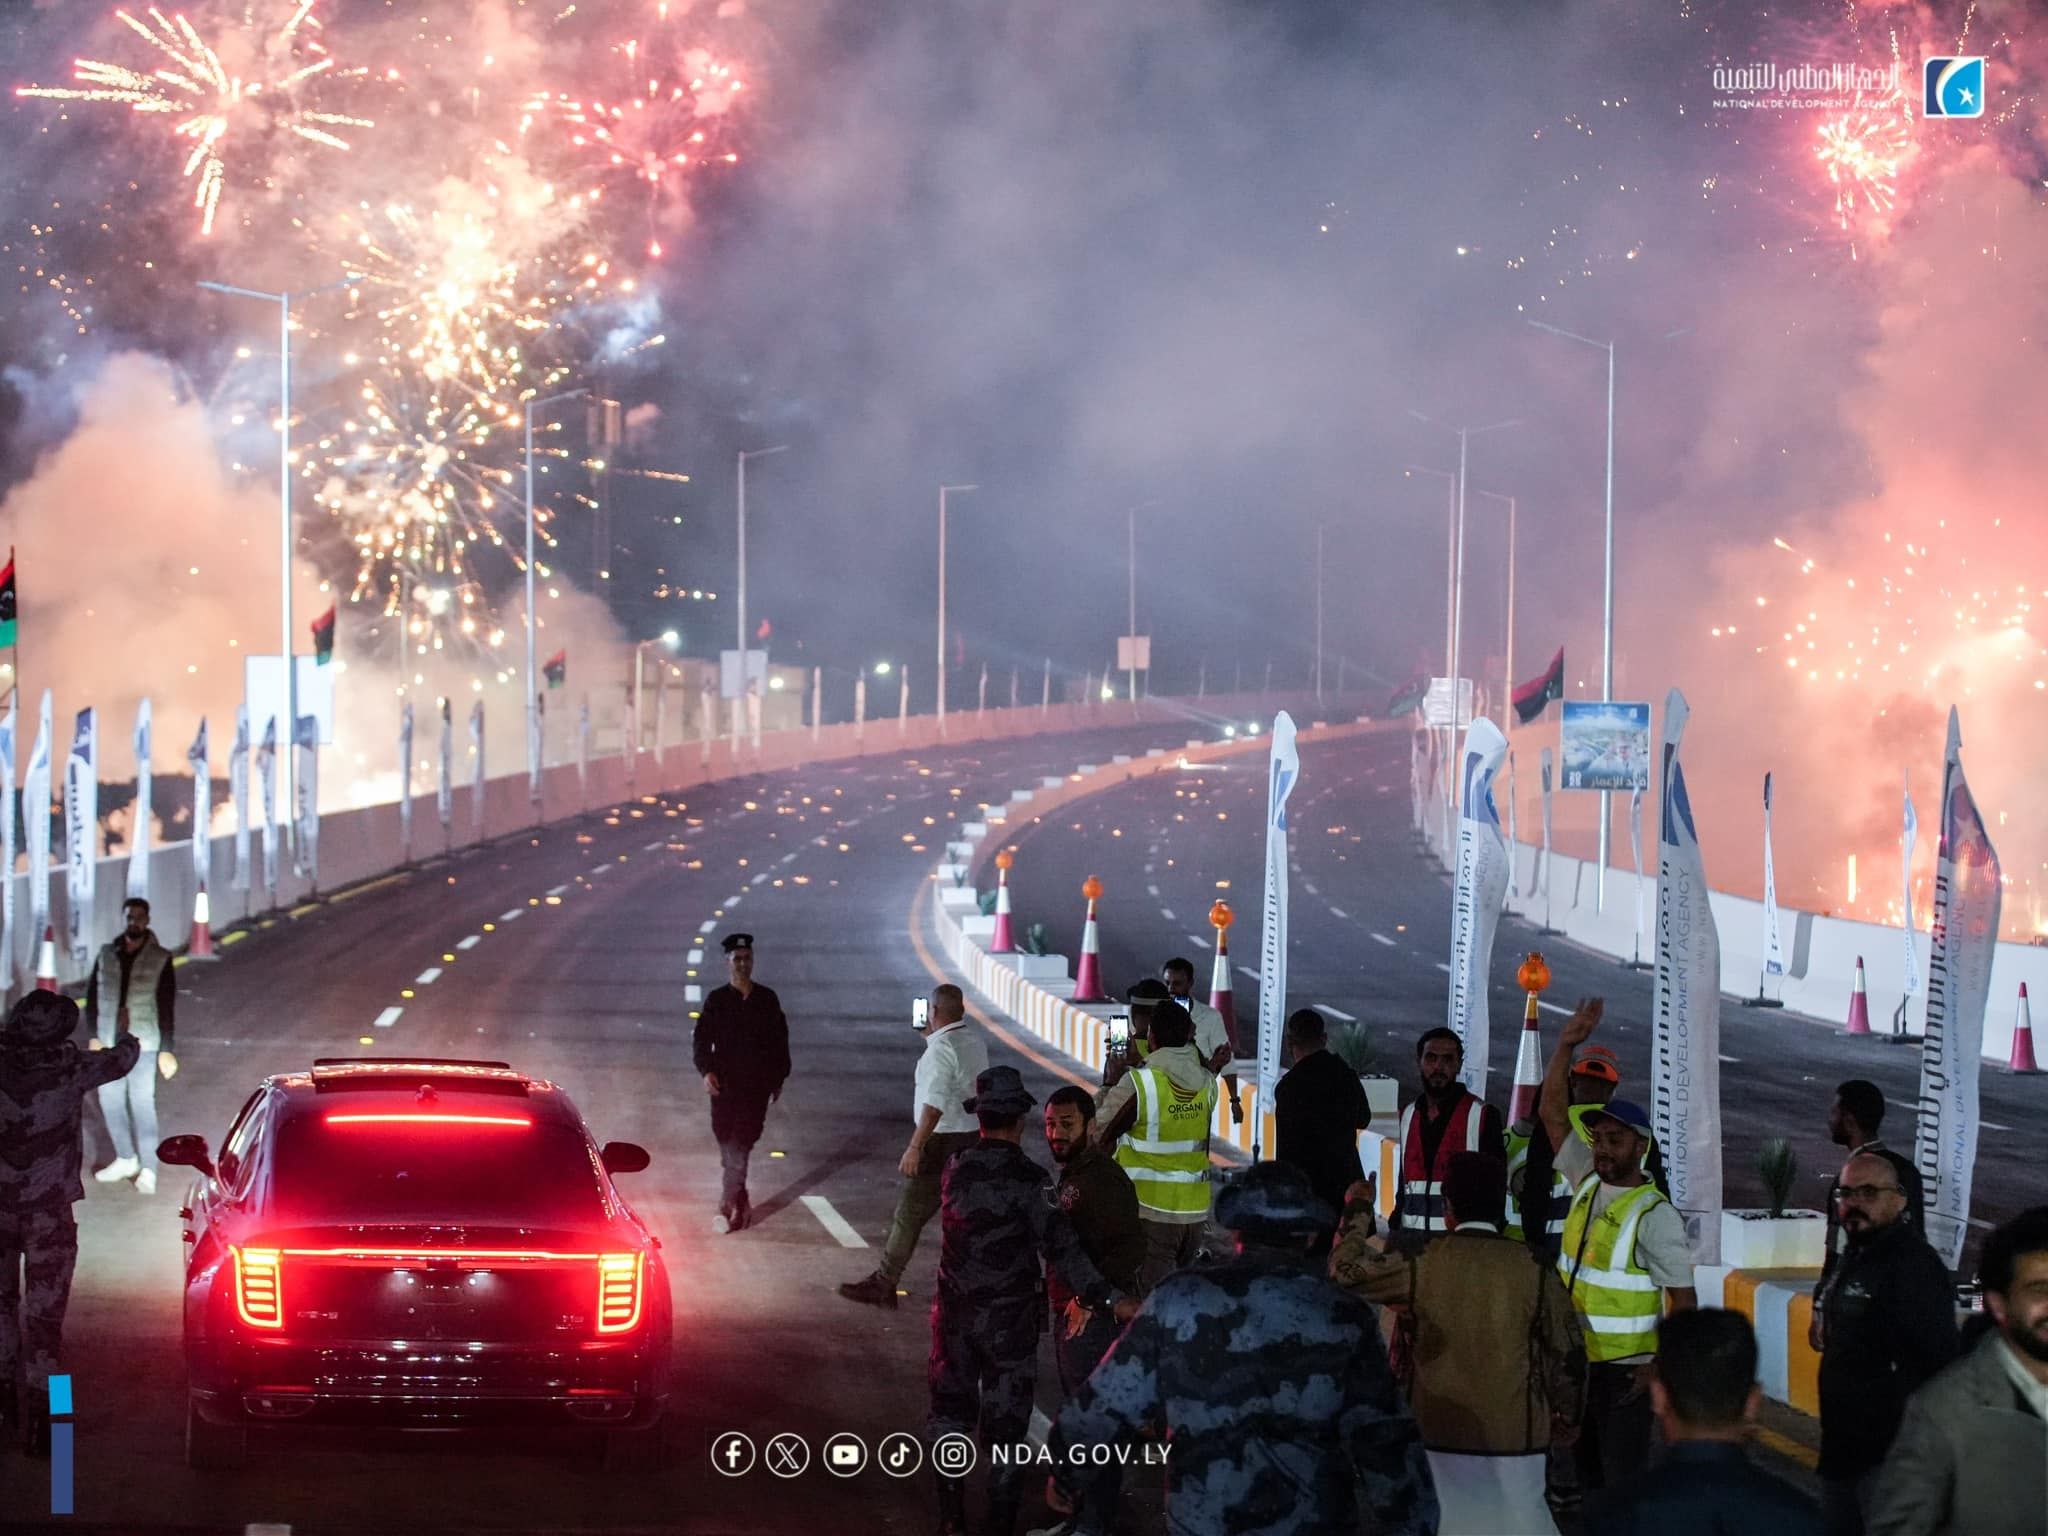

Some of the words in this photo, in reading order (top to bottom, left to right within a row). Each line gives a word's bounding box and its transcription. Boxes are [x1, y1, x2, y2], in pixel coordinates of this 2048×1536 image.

[1676, 866, 1691, 952] AGENCY
[1674, 957, 1690, 1102] DEVELOPMENT
[1922, 977, 1950, 1092] الوطني
[1168, 1102, 1203, 1114] ORGANI
[1173, 1112, 1200, 1121] GROUP
[1674, 1107, 1689, 1203] NATIONAL
[1951, 1118, 1966, 1213] NATIONAL
